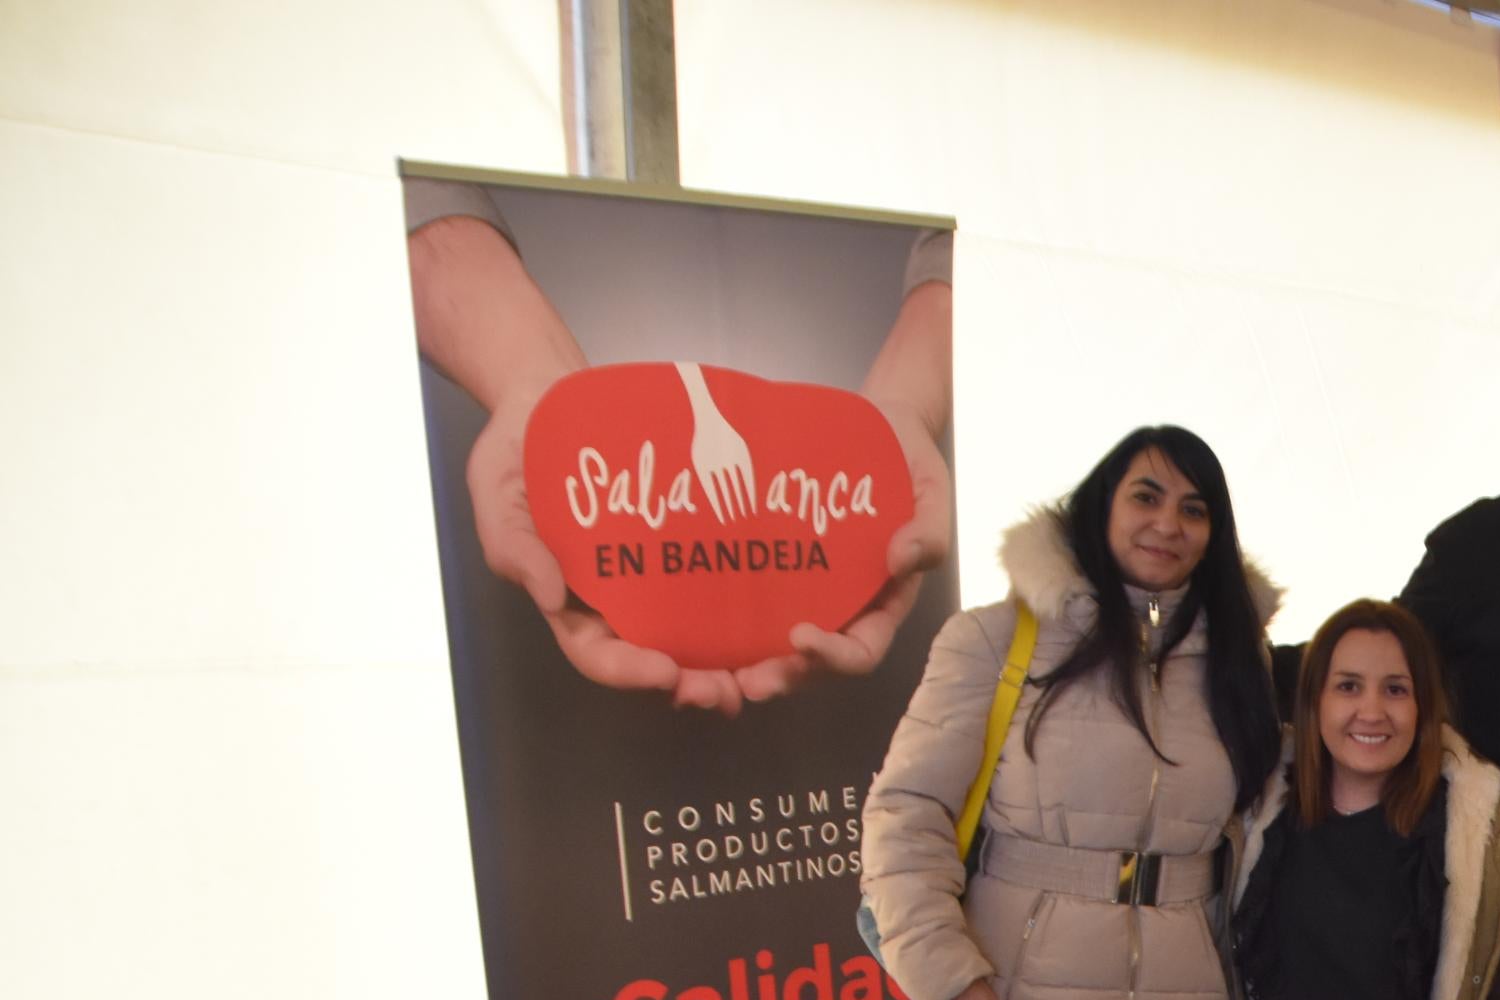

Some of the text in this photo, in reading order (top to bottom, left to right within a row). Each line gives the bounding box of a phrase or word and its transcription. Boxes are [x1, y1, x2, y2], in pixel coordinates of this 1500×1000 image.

[565, 440, 877, 535] Salamanca
[595, 540, 829, 577] EN BANDEJA
[644, 787, 857, 835] CONSUME
[647, 819, 860, 869] PRODUCTOS
[650, 851, 862, 904] SALMANTINOS
